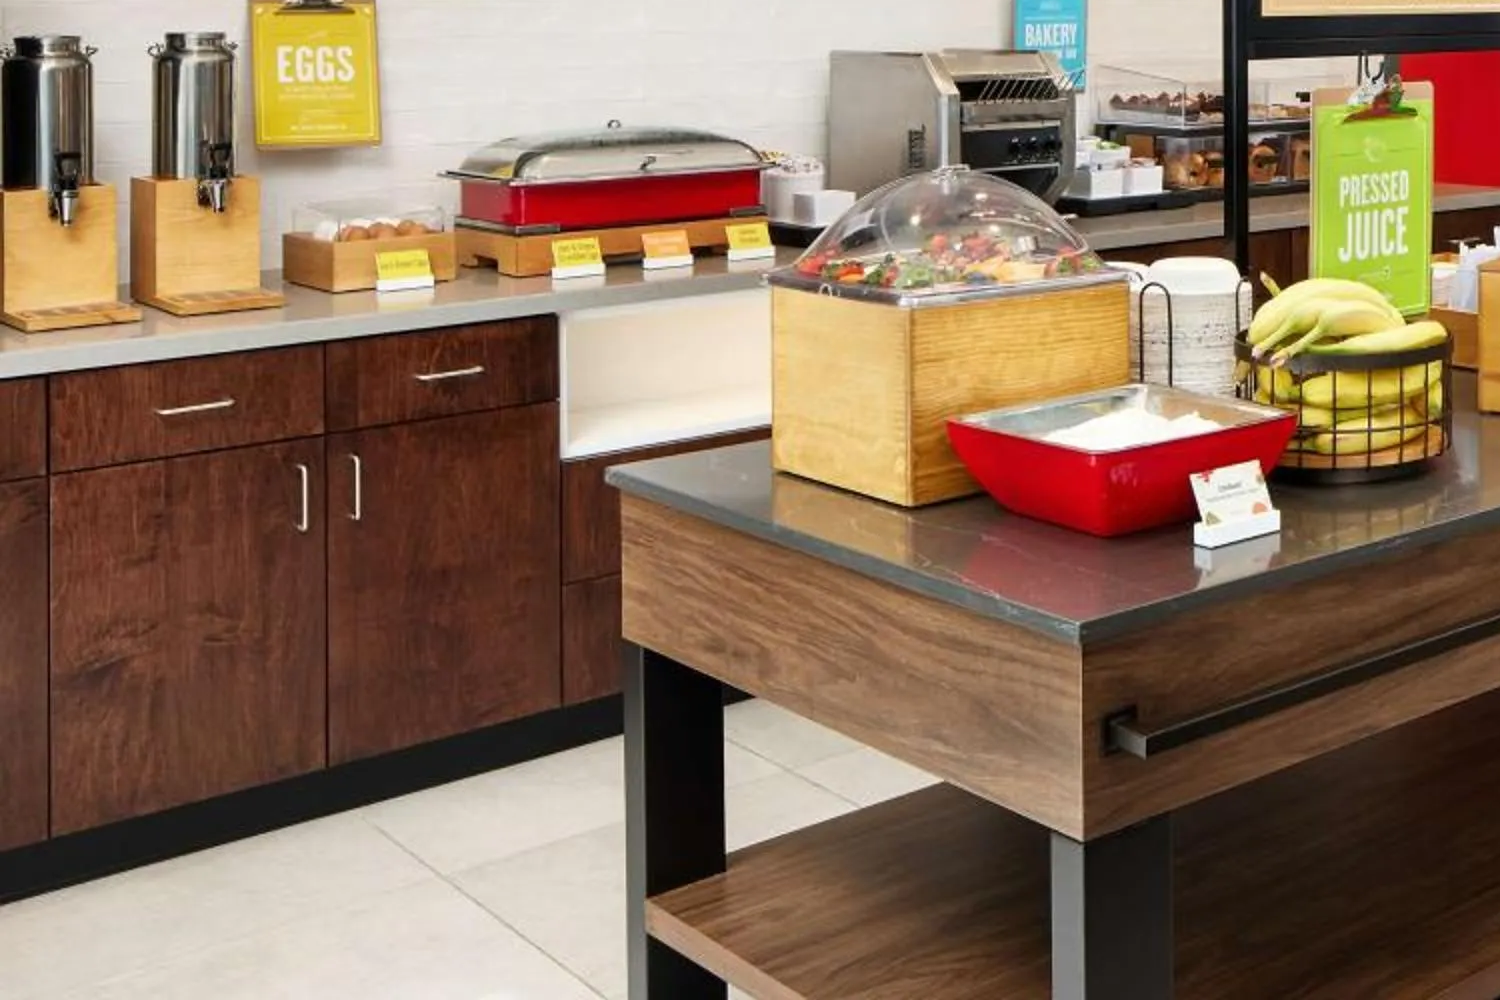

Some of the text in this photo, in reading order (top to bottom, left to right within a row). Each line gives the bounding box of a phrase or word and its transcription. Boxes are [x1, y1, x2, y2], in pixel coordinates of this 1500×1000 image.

[1024, 23, 1077, 47] BAKERY
[276, 45, 355, 83] EGGS
[1339, 169, 1409, 209] PRESSED
[1338, 206, 1409, 264] JUICE
